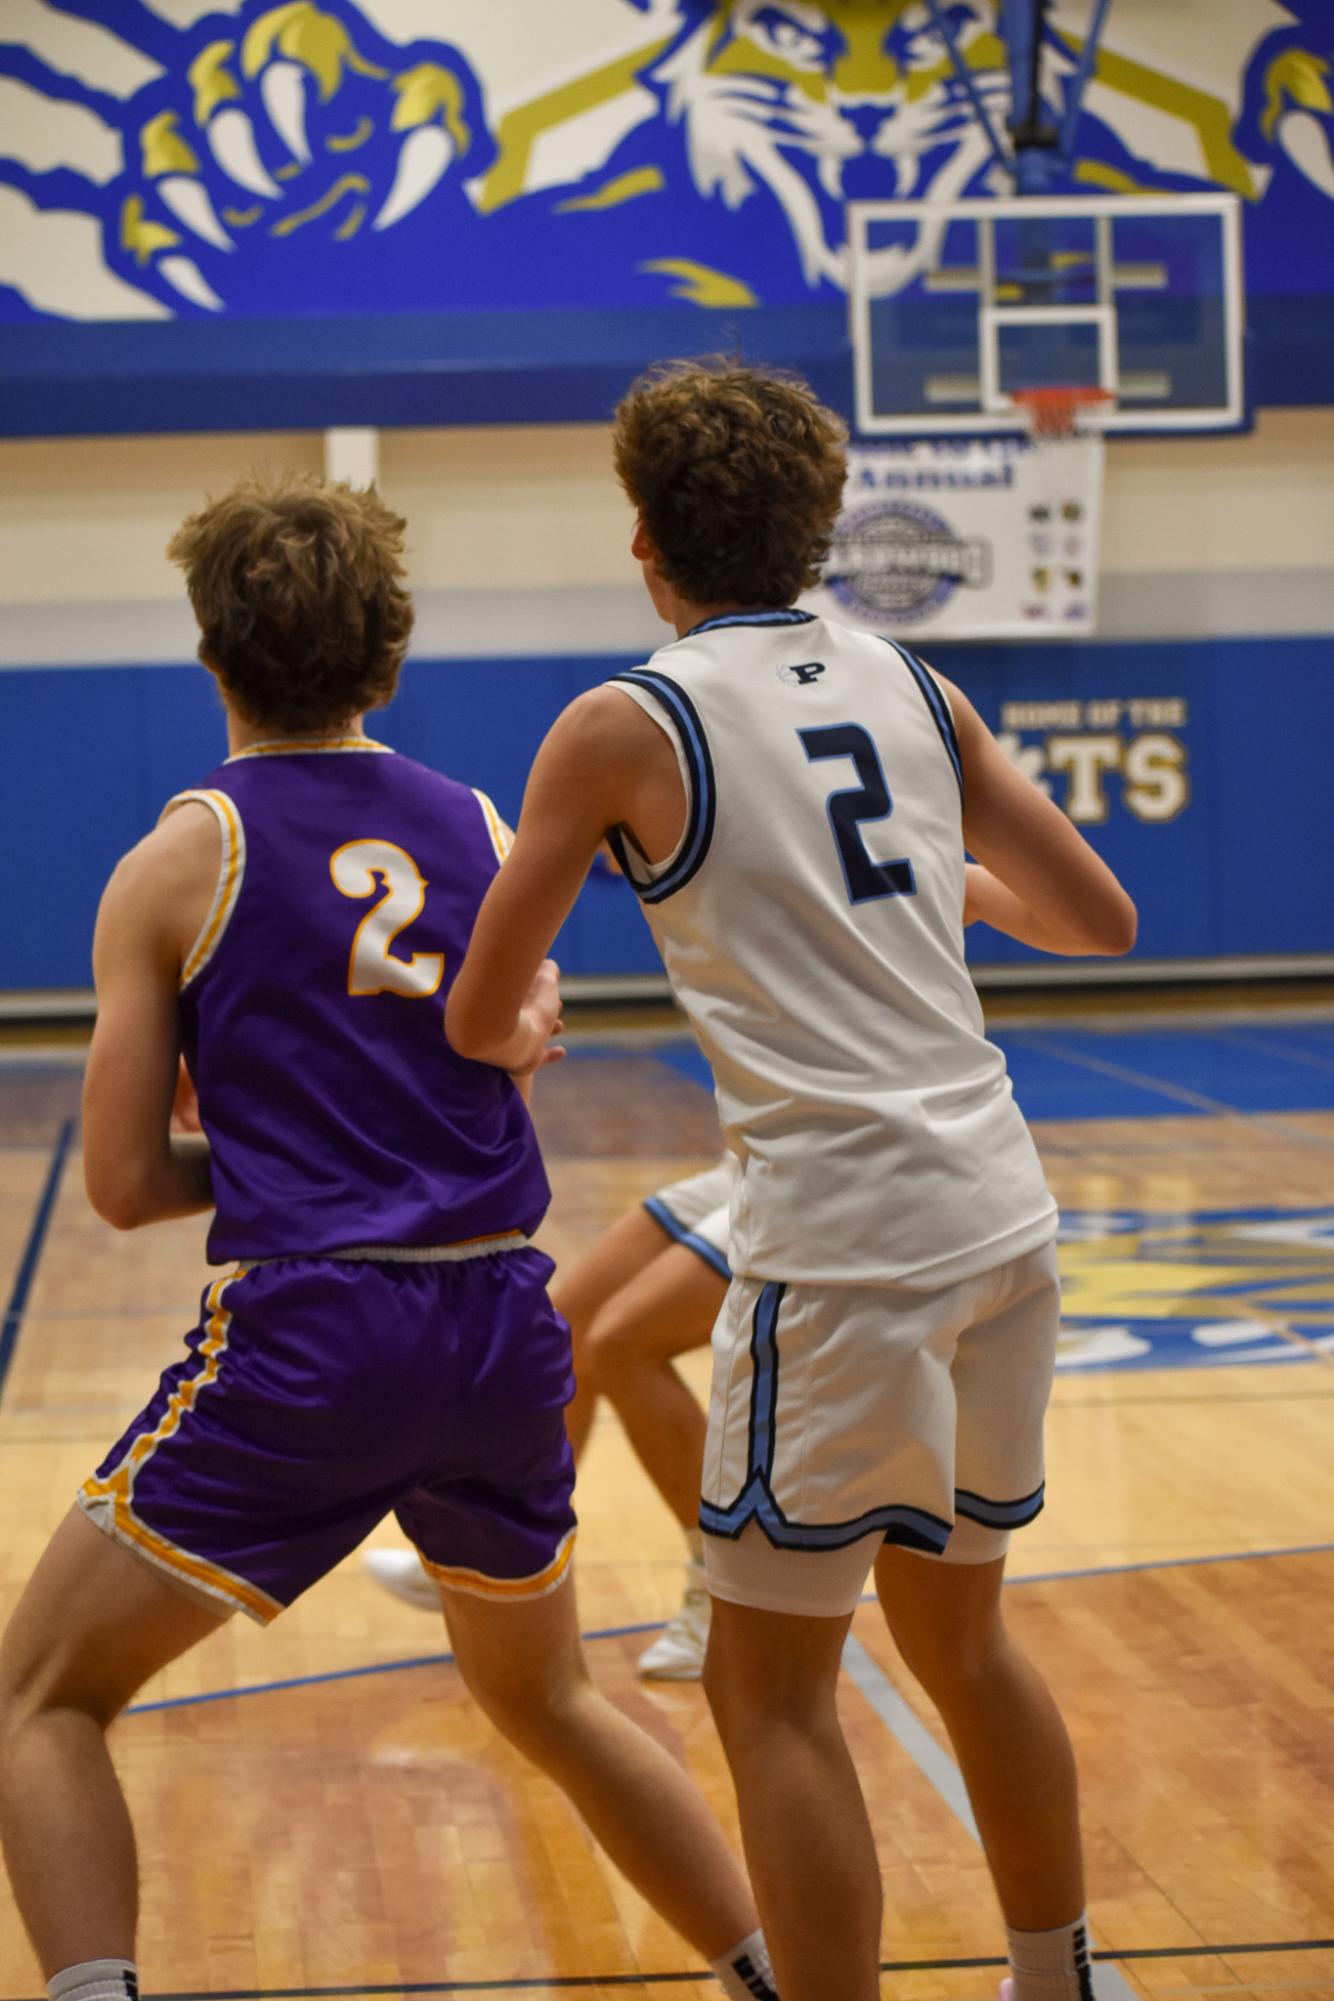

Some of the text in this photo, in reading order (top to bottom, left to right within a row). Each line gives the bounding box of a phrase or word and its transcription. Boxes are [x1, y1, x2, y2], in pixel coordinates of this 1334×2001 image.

[790, 662, 826, 685] P
[1003, 698, 1187, 728] HOME OF THE
[795, 721, 917, 906] 2
[329, 838, 446, 998] 2
